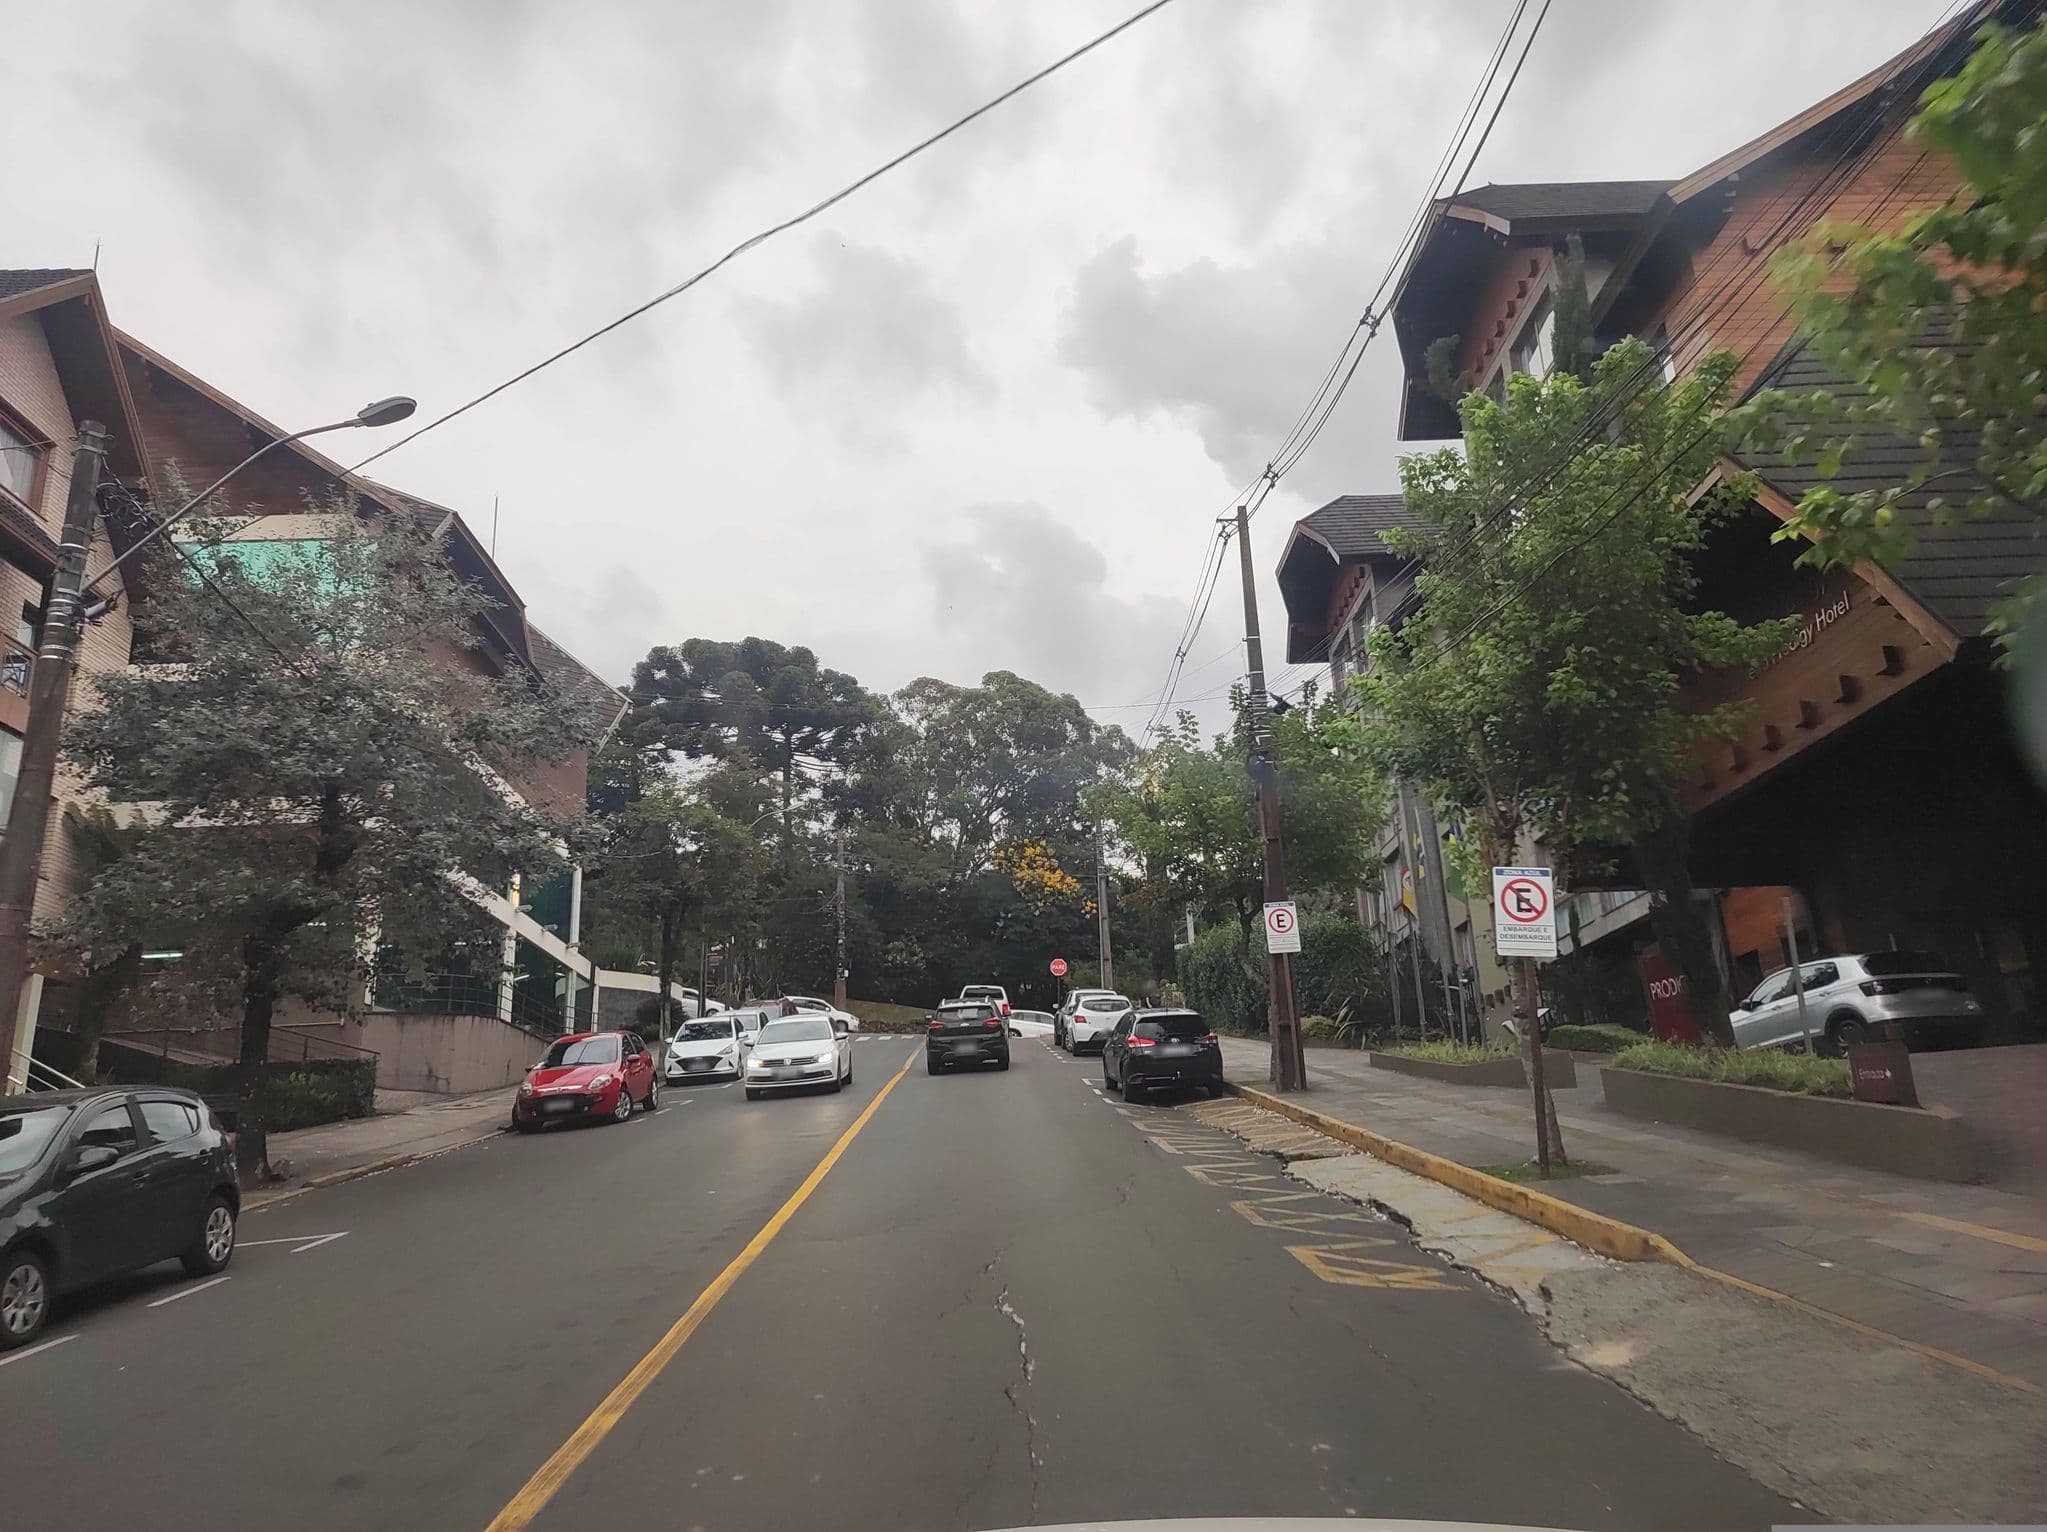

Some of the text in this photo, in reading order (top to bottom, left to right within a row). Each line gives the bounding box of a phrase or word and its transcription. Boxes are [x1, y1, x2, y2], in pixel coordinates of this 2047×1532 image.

[1815, 590, 1850, 631] Hotel
[1276, 913, 1286, 928] E
[1499, 933, 1552, 941] DESEMBARQUE
